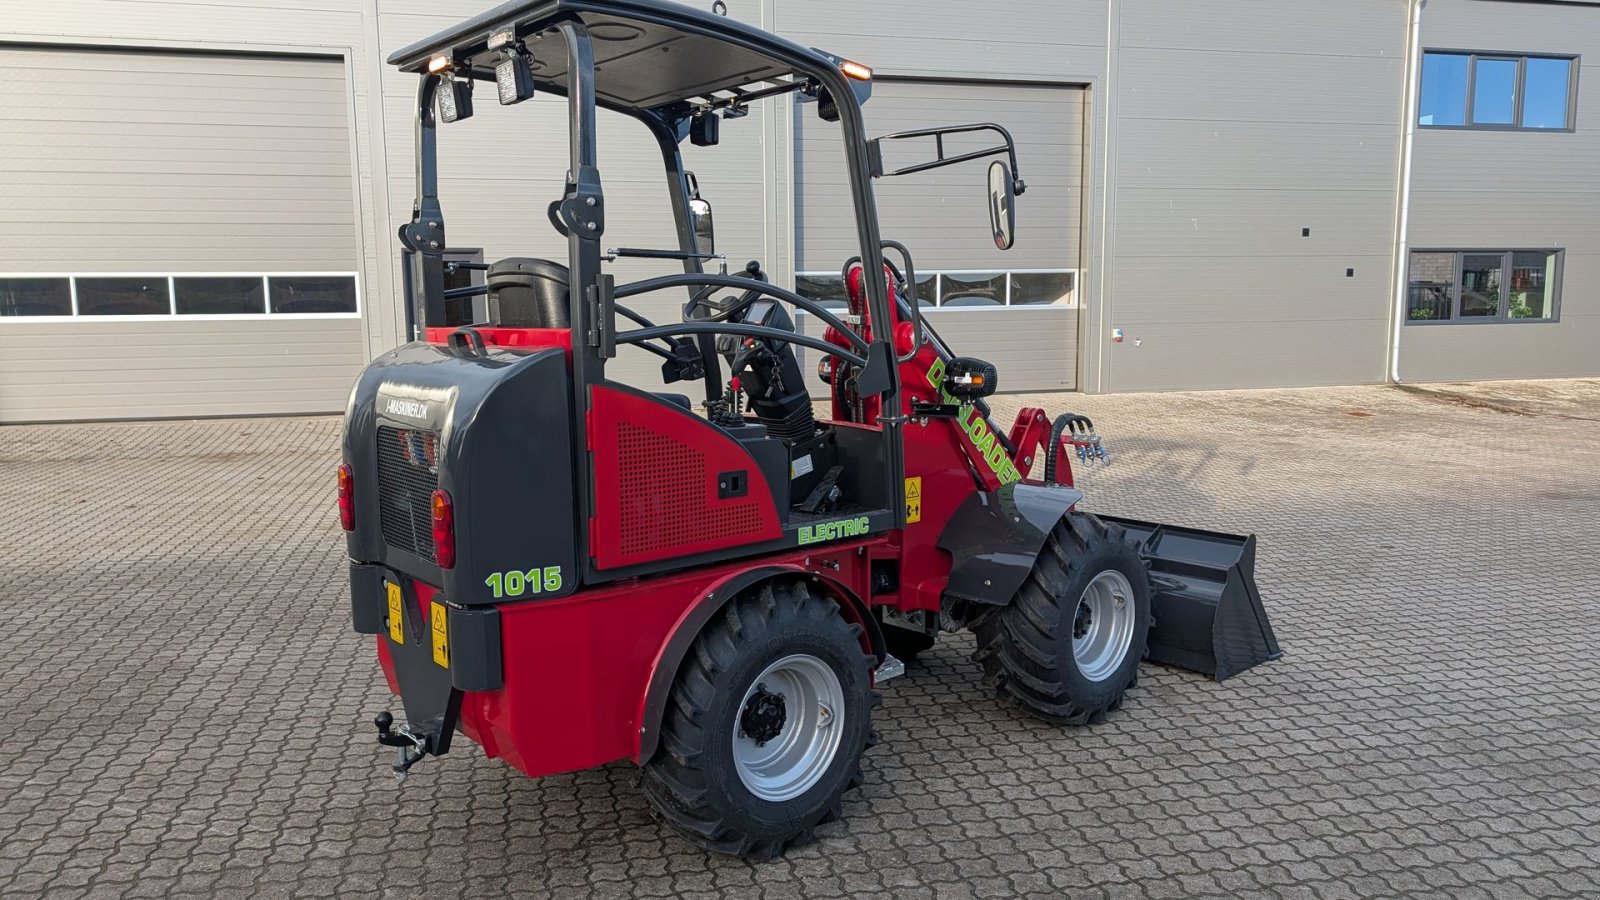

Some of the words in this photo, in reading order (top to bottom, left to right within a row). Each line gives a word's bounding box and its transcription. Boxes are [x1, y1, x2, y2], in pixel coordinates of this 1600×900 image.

[385, 398, 428, 419] J-MASKINER.DK
[798, 517, 870, 546] ELECTRIC
[485, 565, 562, 597] 1015
